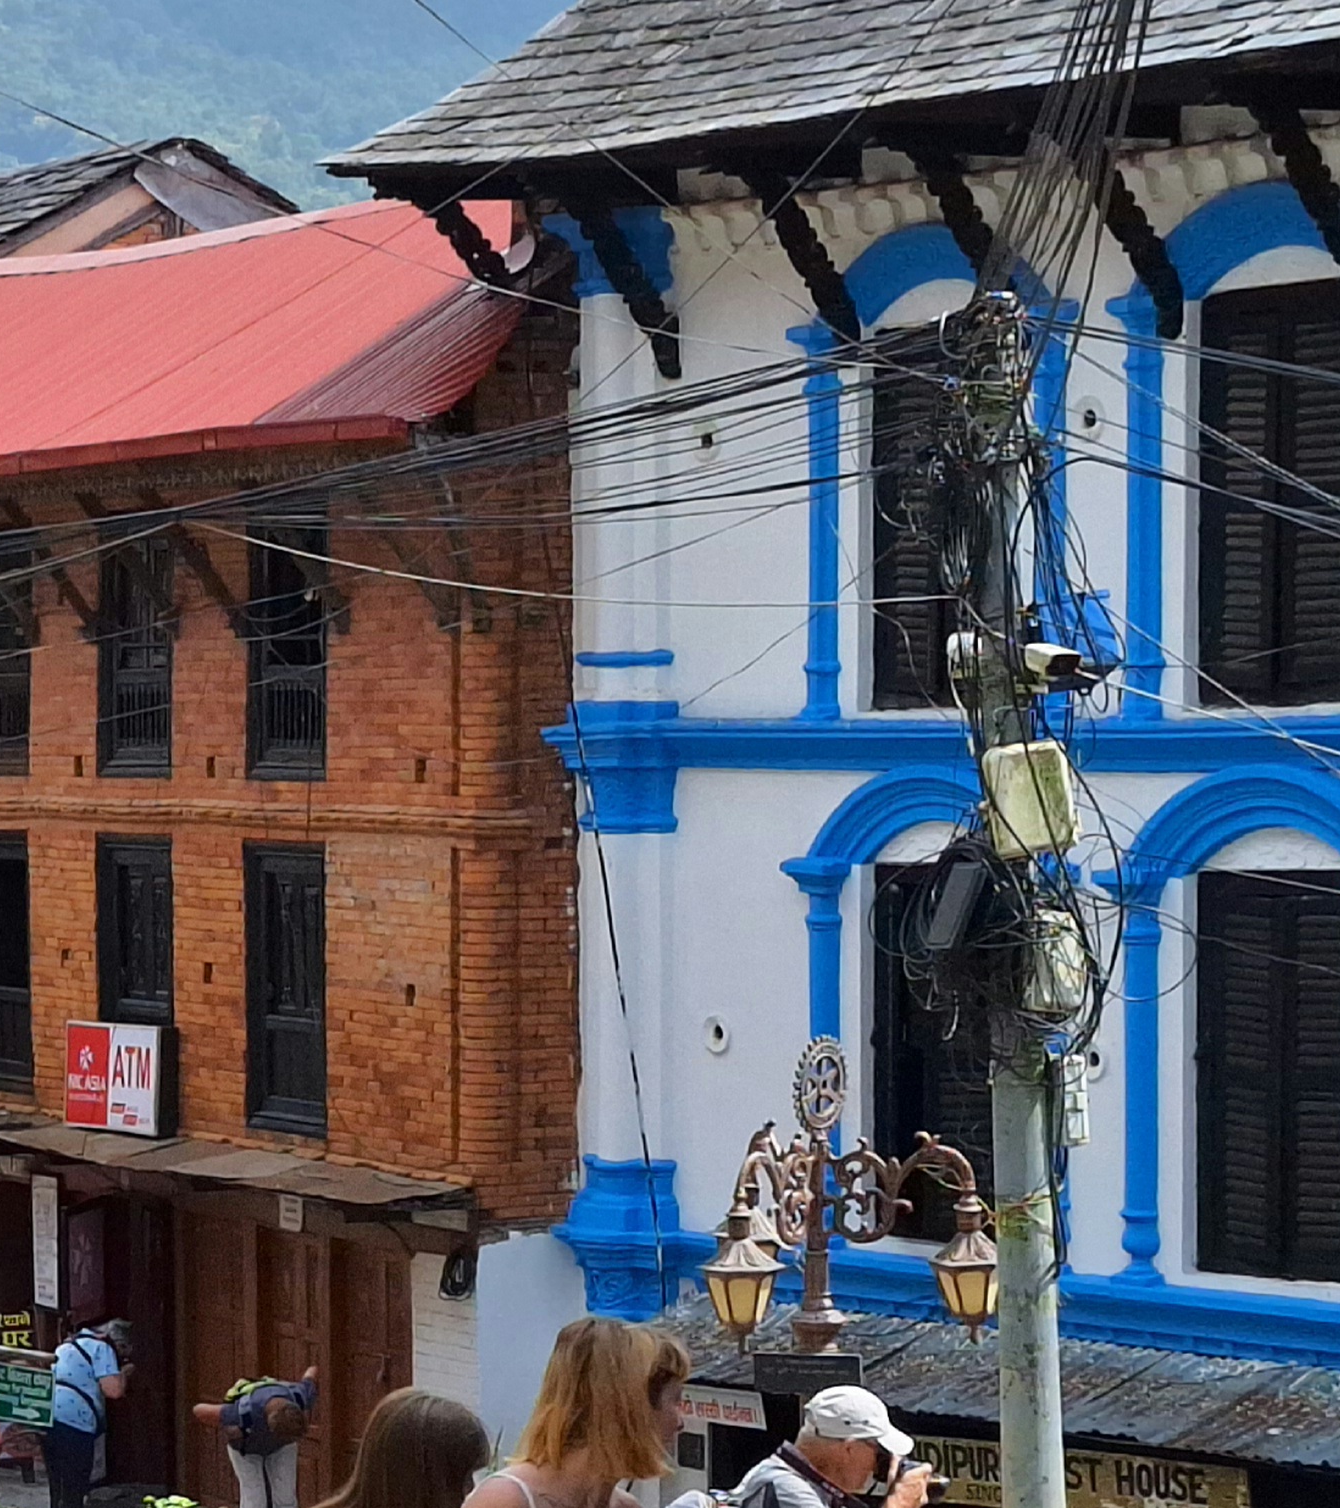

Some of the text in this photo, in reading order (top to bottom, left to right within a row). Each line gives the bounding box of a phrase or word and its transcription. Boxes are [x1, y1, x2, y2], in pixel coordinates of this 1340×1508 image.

[112, 1045, 151, 1091] ATM
[916, 1439, 1000, 1483] DIPUR
[1114, 1459, 1209, 1505] HOUSE
[965, 1483, 1002, 1501] SINC
